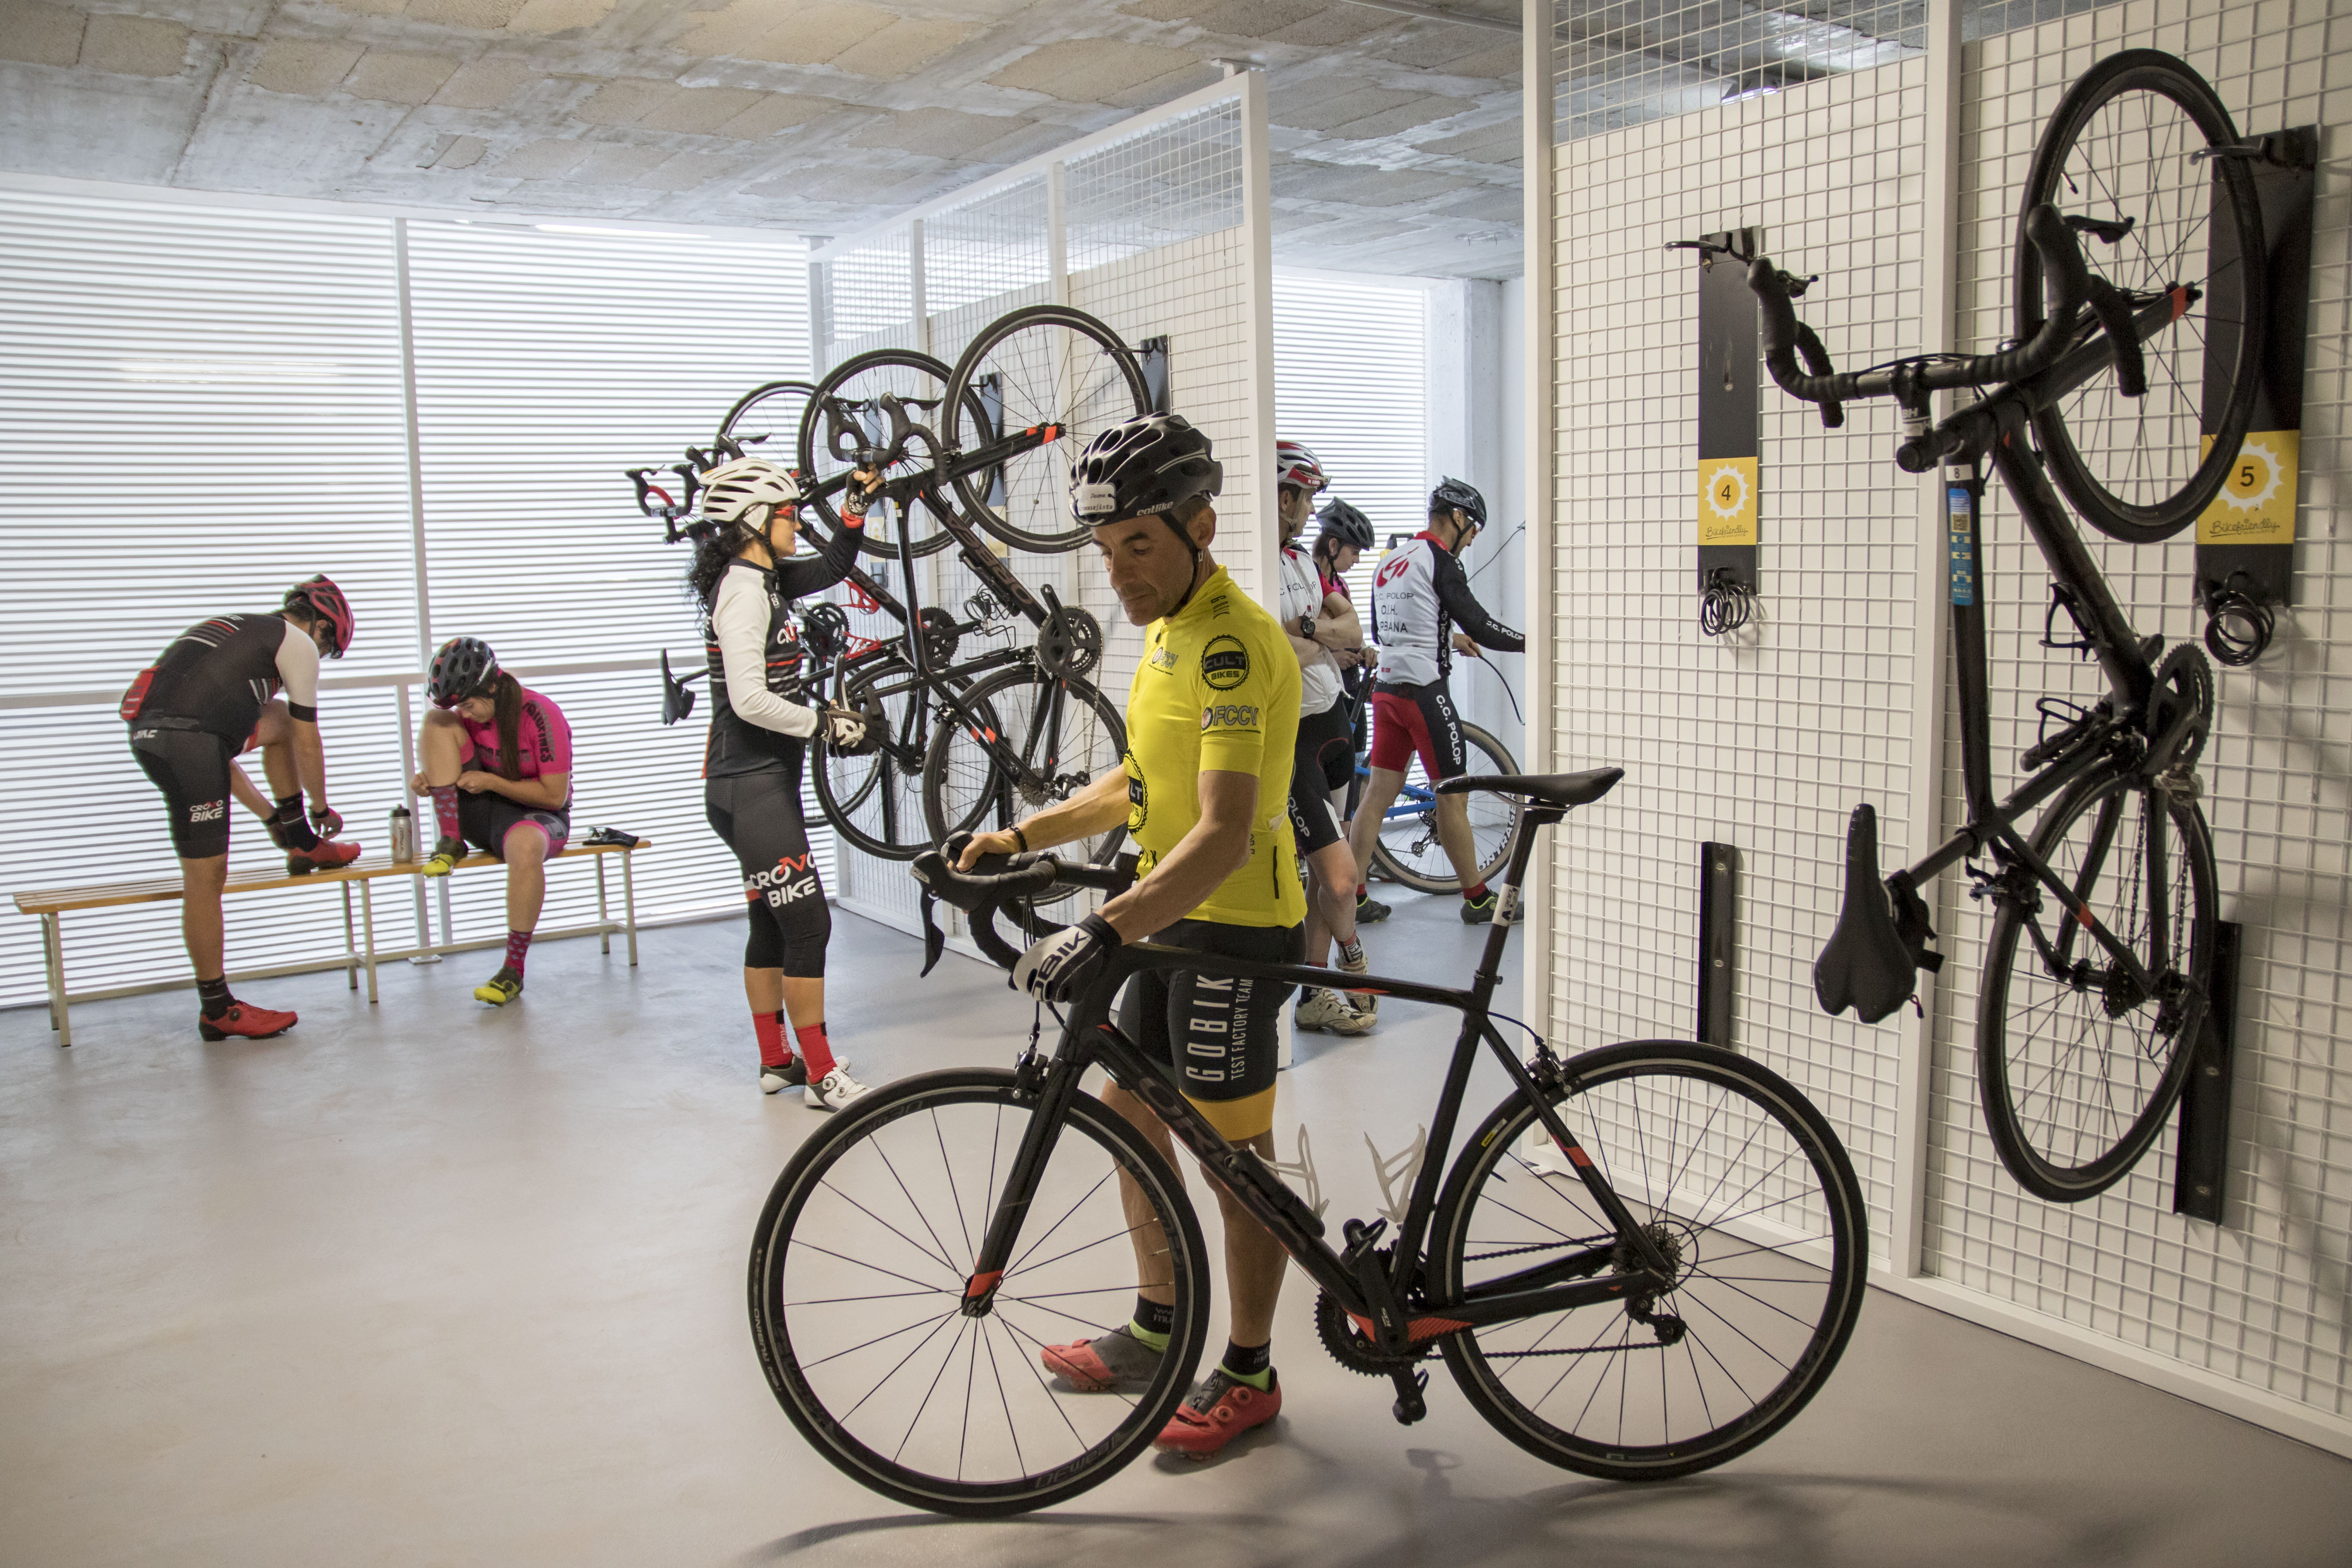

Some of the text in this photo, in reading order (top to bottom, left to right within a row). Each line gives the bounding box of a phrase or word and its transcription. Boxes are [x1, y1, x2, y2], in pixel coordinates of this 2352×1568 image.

[2240, 466, 2254, 487] 5
[1721, 484, 1731, 501] 4
[1137, 501, 1173, 516] catlike
[1705, 524, 1748, 538] Bikefriendly
[2209, 518, 2280, 535] Bikefriendly
[1379, 621, 1408, 633] RBANA
[1501, 627, 1524, 640] POLOP
[1204, 655, 1245, 669] CULT
[1211, 671, 1240, 680] BIKES
[1213, 704, 1259, 726] FCCV
[1436, 695, 1461, 765] C.C. POLOP
[1130, 782, 1142, 799] LT
[190, 806, 224, 822] BIKE
[1288, 792, 1311, 837] OLOP
[1478, 792, 1517, 872] ONTRAGER
[767, 875, 816, 908] BIKE
[1032, 931, 1088, 1002] OBIK
[1185, 974, 1234, 1082] GOBIK
[1231, 979, 1254, 1081] TEST FACTORY TEAM
